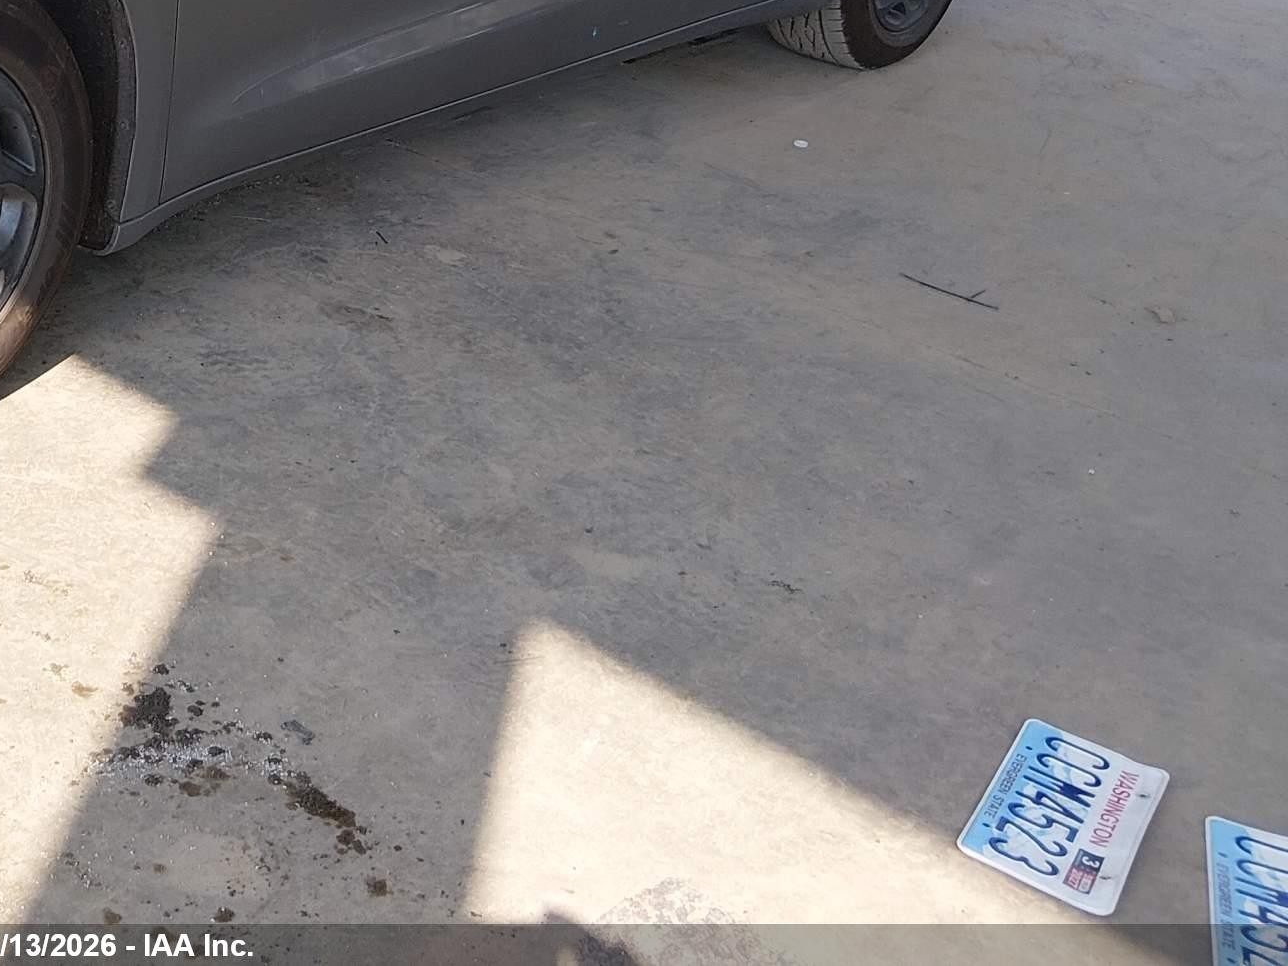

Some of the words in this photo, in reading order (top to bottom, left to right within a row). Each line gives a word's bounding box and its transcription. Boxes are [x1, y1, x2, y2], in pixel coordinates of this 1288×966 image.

[997, 753, 1027, 795] EVERGREEN
[984, 794, 1005, 819] STATE
[988, 736, 1110, 876] CCM4523
[1089, 771, 1139, 848] WASHINGTON
